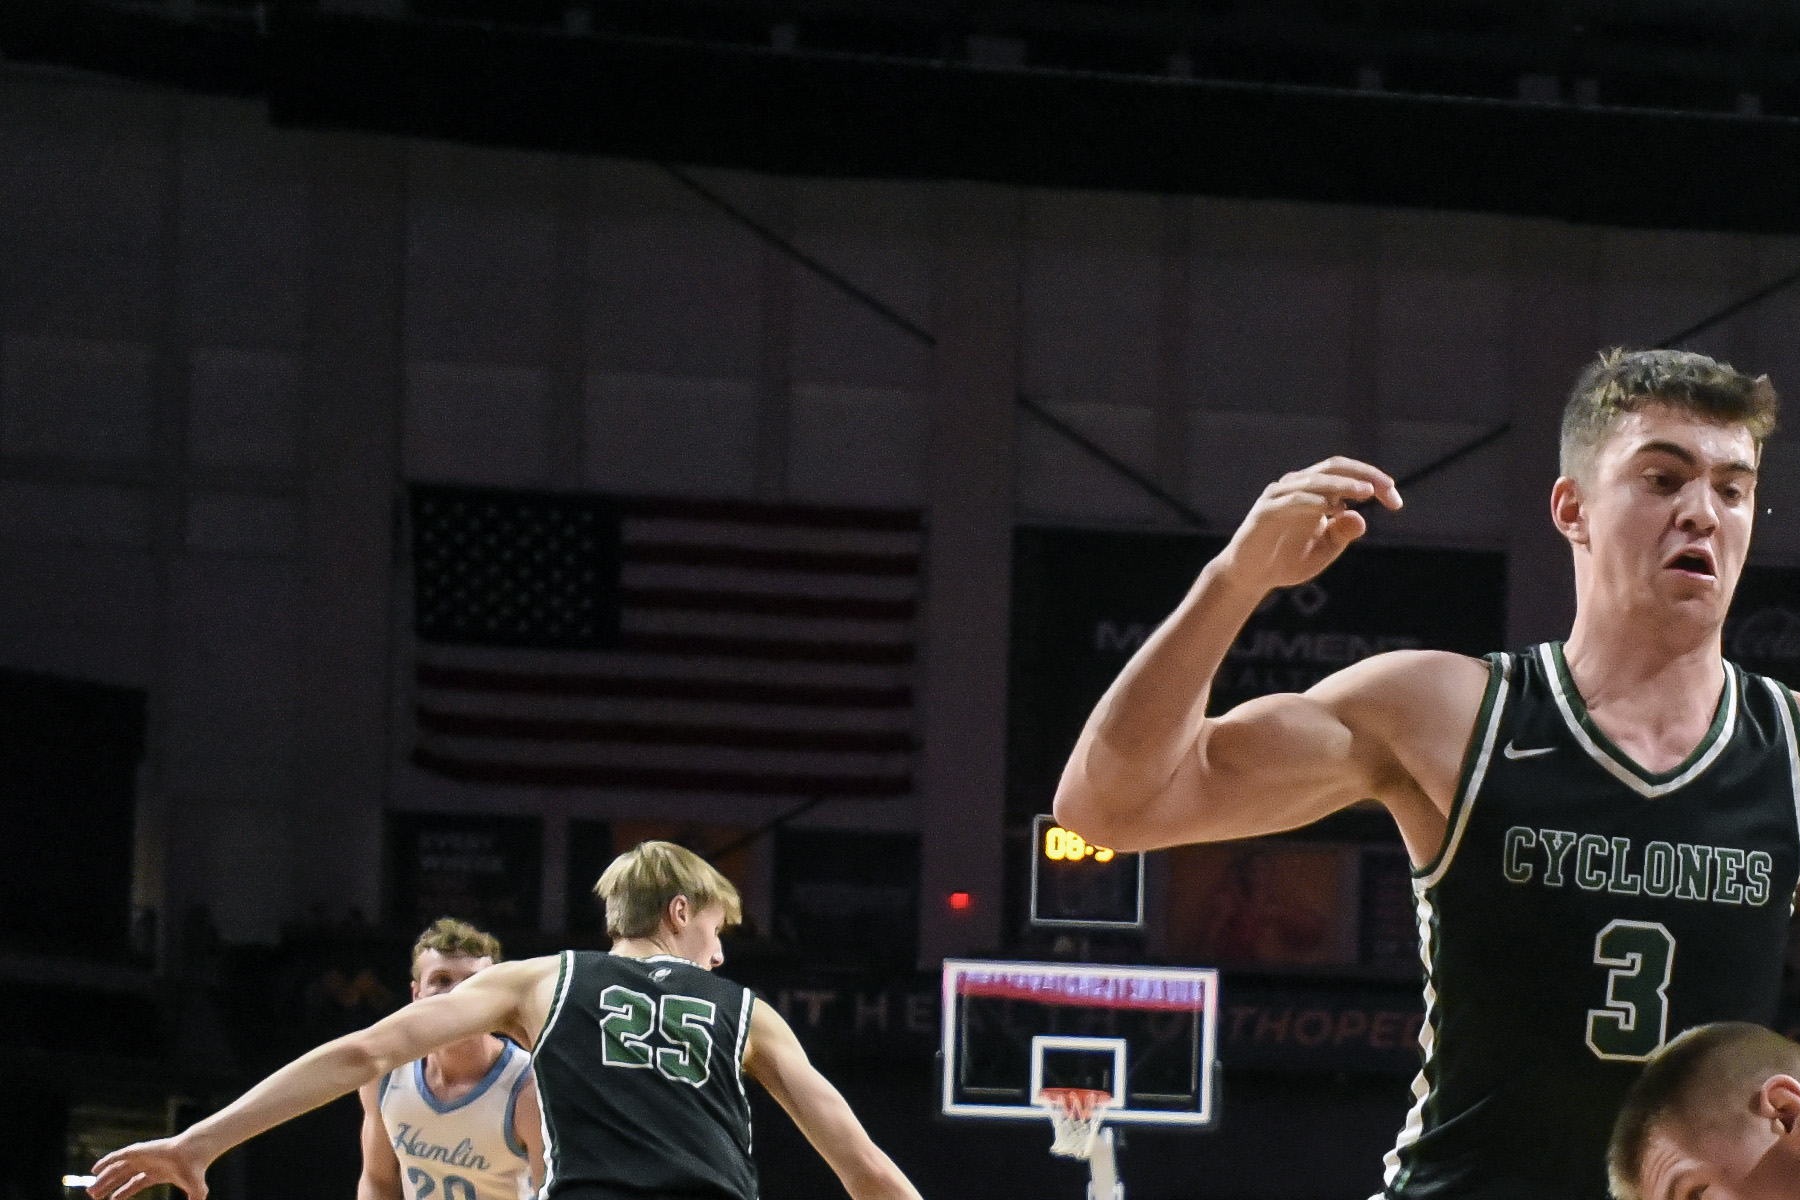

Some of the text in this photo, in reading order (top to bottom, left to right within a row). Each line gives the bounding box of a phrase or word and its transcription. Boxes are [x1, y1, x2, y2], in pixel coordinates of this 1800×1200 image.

[1094, 620, 1421, 663] MUMEN
[1503, 825, 1773, 906] CYCLONES
[1585, 918, 1676, 1061] 3
[600, 984, 716, 1088] 25
[394, 1122, 491, 1171] Hamlin
